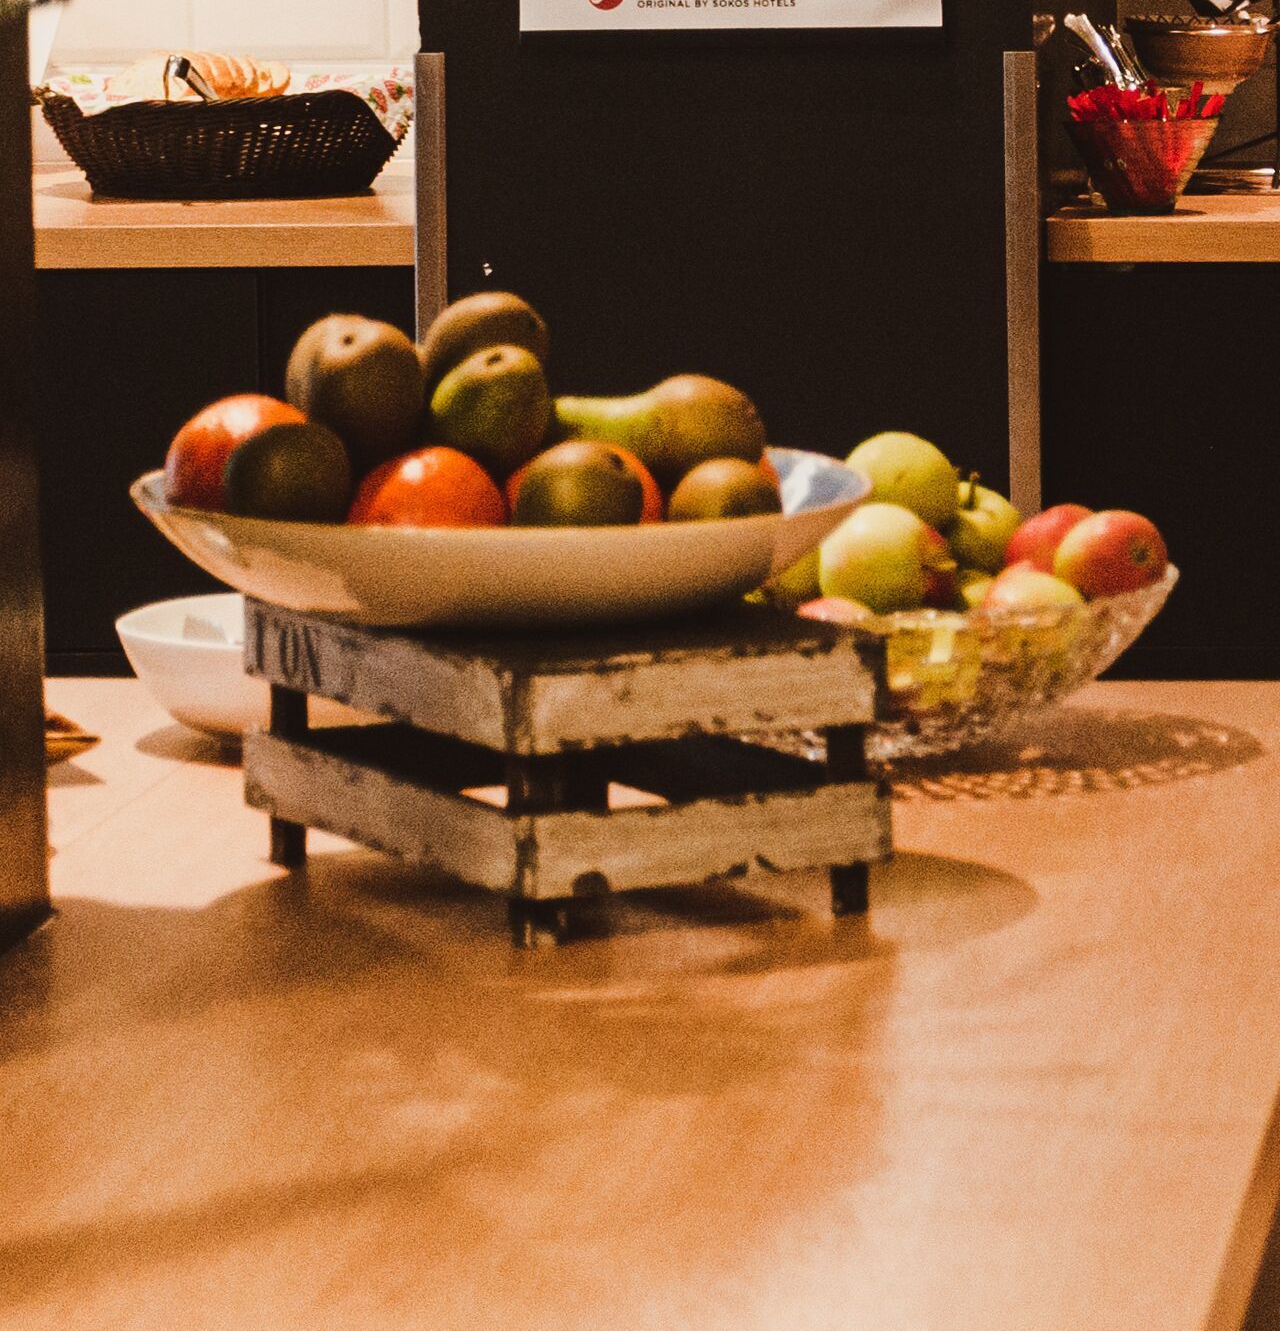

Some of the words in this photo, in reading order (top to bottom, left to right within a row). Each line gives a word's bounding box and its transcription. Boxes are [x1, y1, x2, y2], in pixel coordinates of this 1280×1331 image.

[637, 0, 689, 8] ORIGINAL
[713, 0, 749, 7] SOKOS
[753, 0, 795, 7] HOTELS
